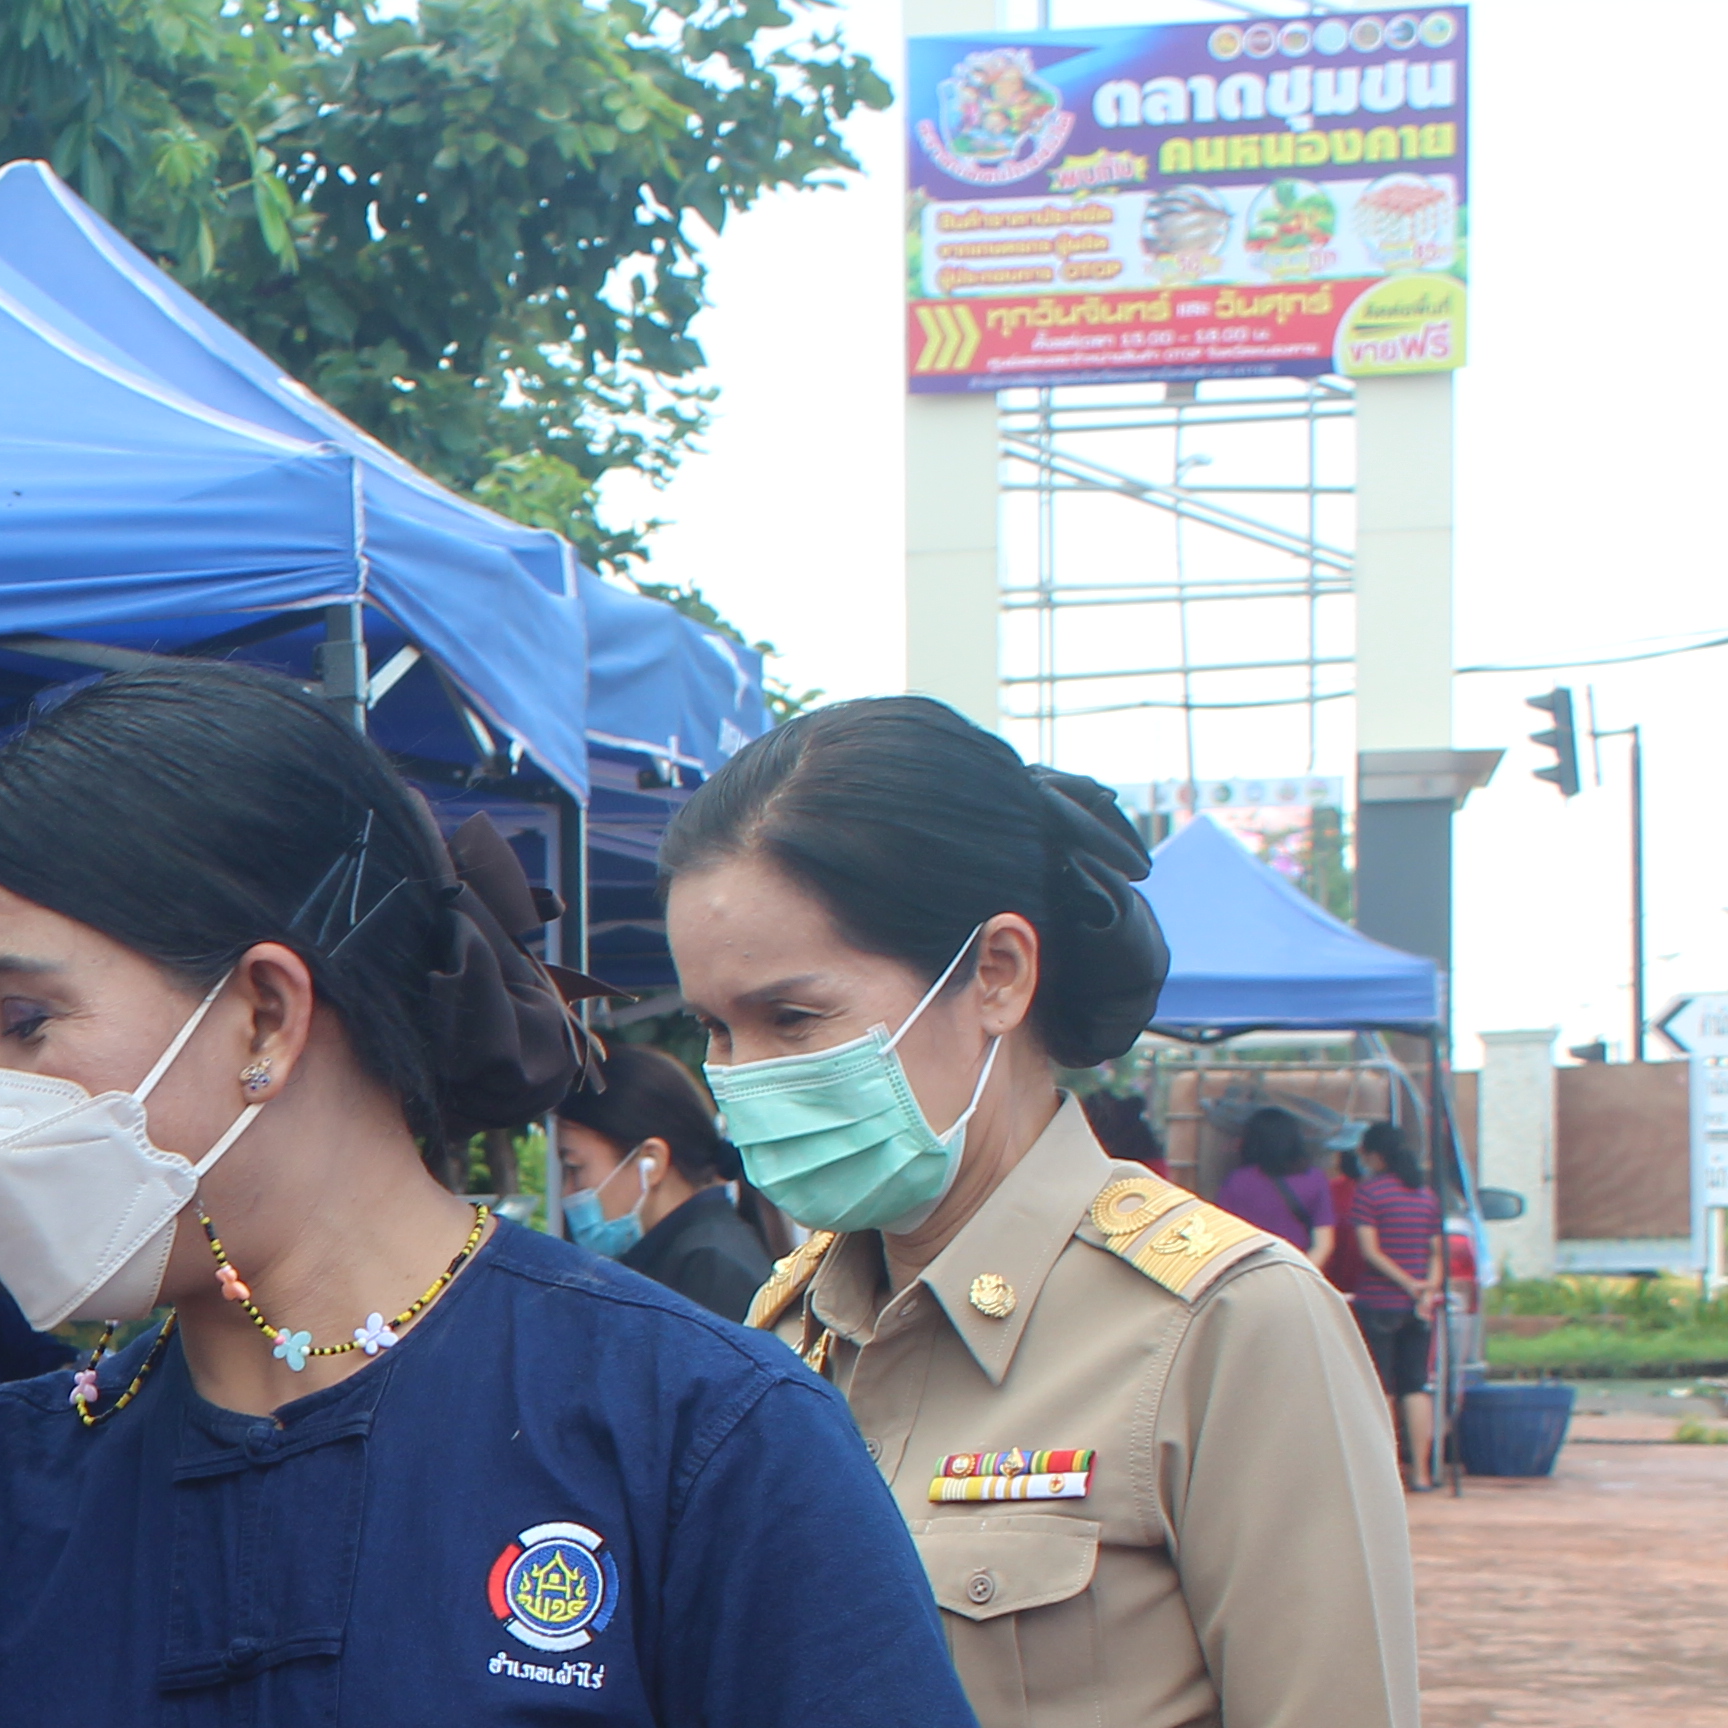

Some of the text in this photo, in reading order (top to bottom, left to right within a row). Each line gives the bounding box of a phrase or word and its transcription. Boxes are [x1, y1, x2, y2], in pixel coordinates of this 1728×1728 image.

[1093, 60, 1455, 131] ตลาดชุมชน
[1158, 123, 1456, 174] คนหนองคาย
[1215, 283, 1334, 325] วันศุกร์
[487, 1650, 605, 1690] อำเภอเฝ้าไร่
